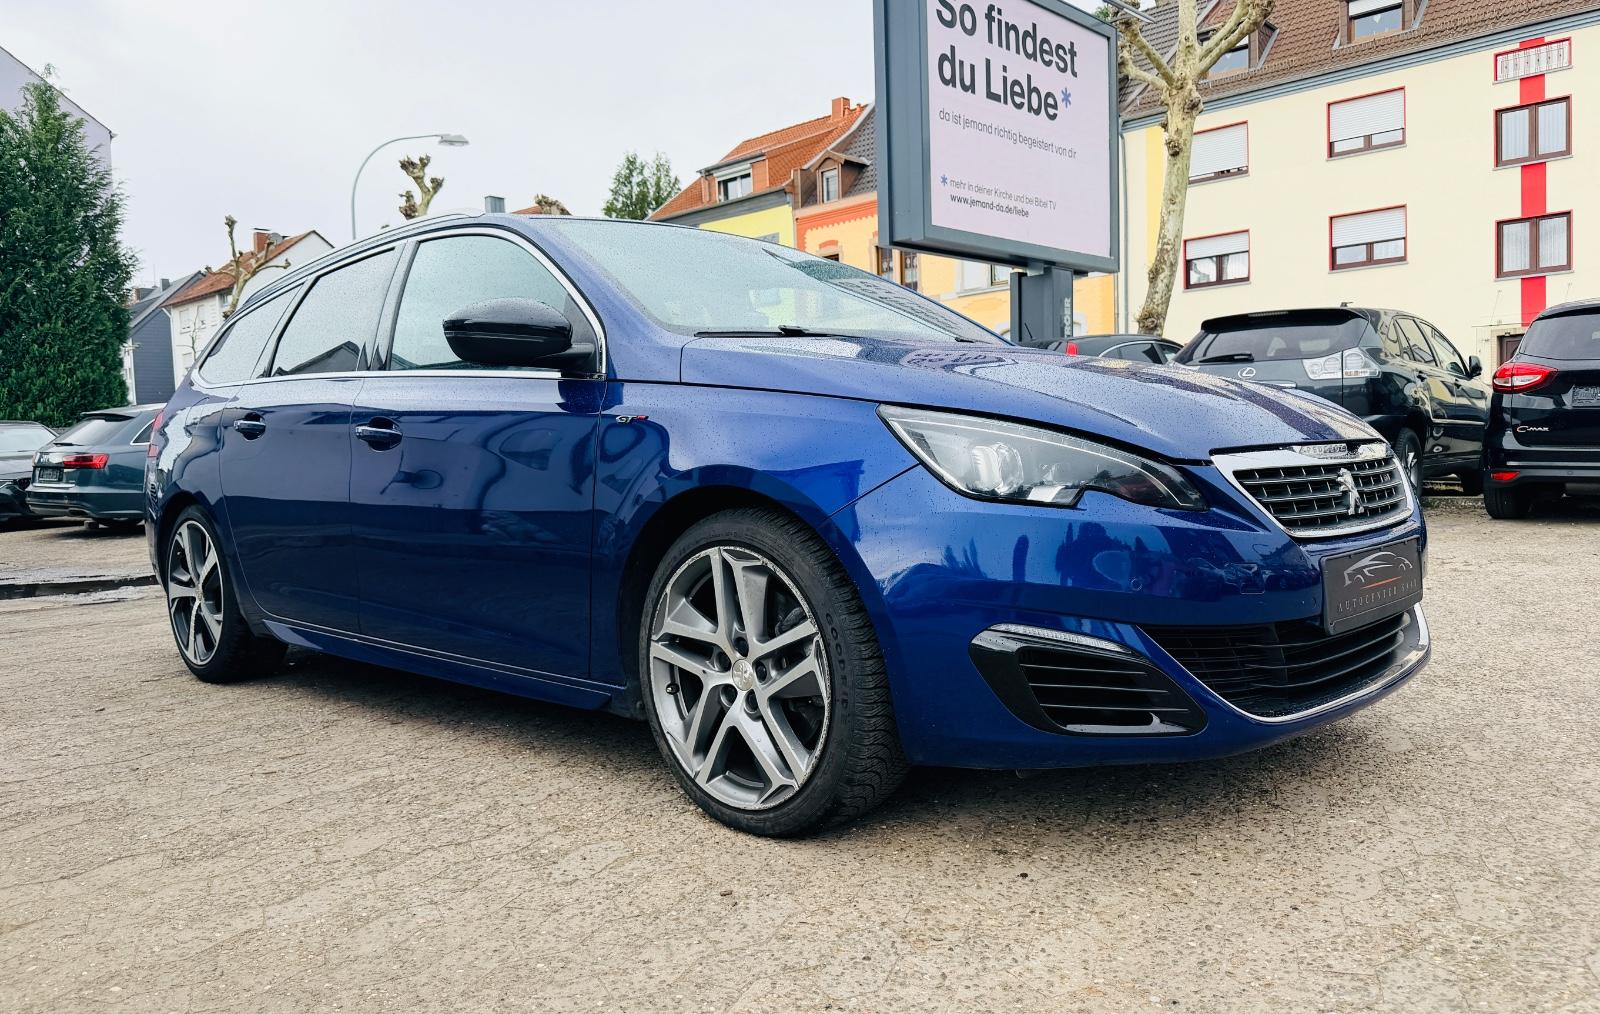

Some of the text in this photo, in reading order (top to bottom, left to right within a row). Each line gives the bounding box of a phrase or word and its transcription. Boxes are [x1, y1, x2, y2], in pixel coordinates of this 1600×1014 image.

[936, 0, 1077, 78] So findest
[938, 44, 976, 95] du
[939, 108, 1077, 159] da ist jemand richtig begeistert von dir
[950, 178, 1057, 211] mehr in deiner Kirche und bei Bibel TV
[950, 193, 1029, 218] www.jemand-da.de/liebe
[615, 415, 638, 424] GT
